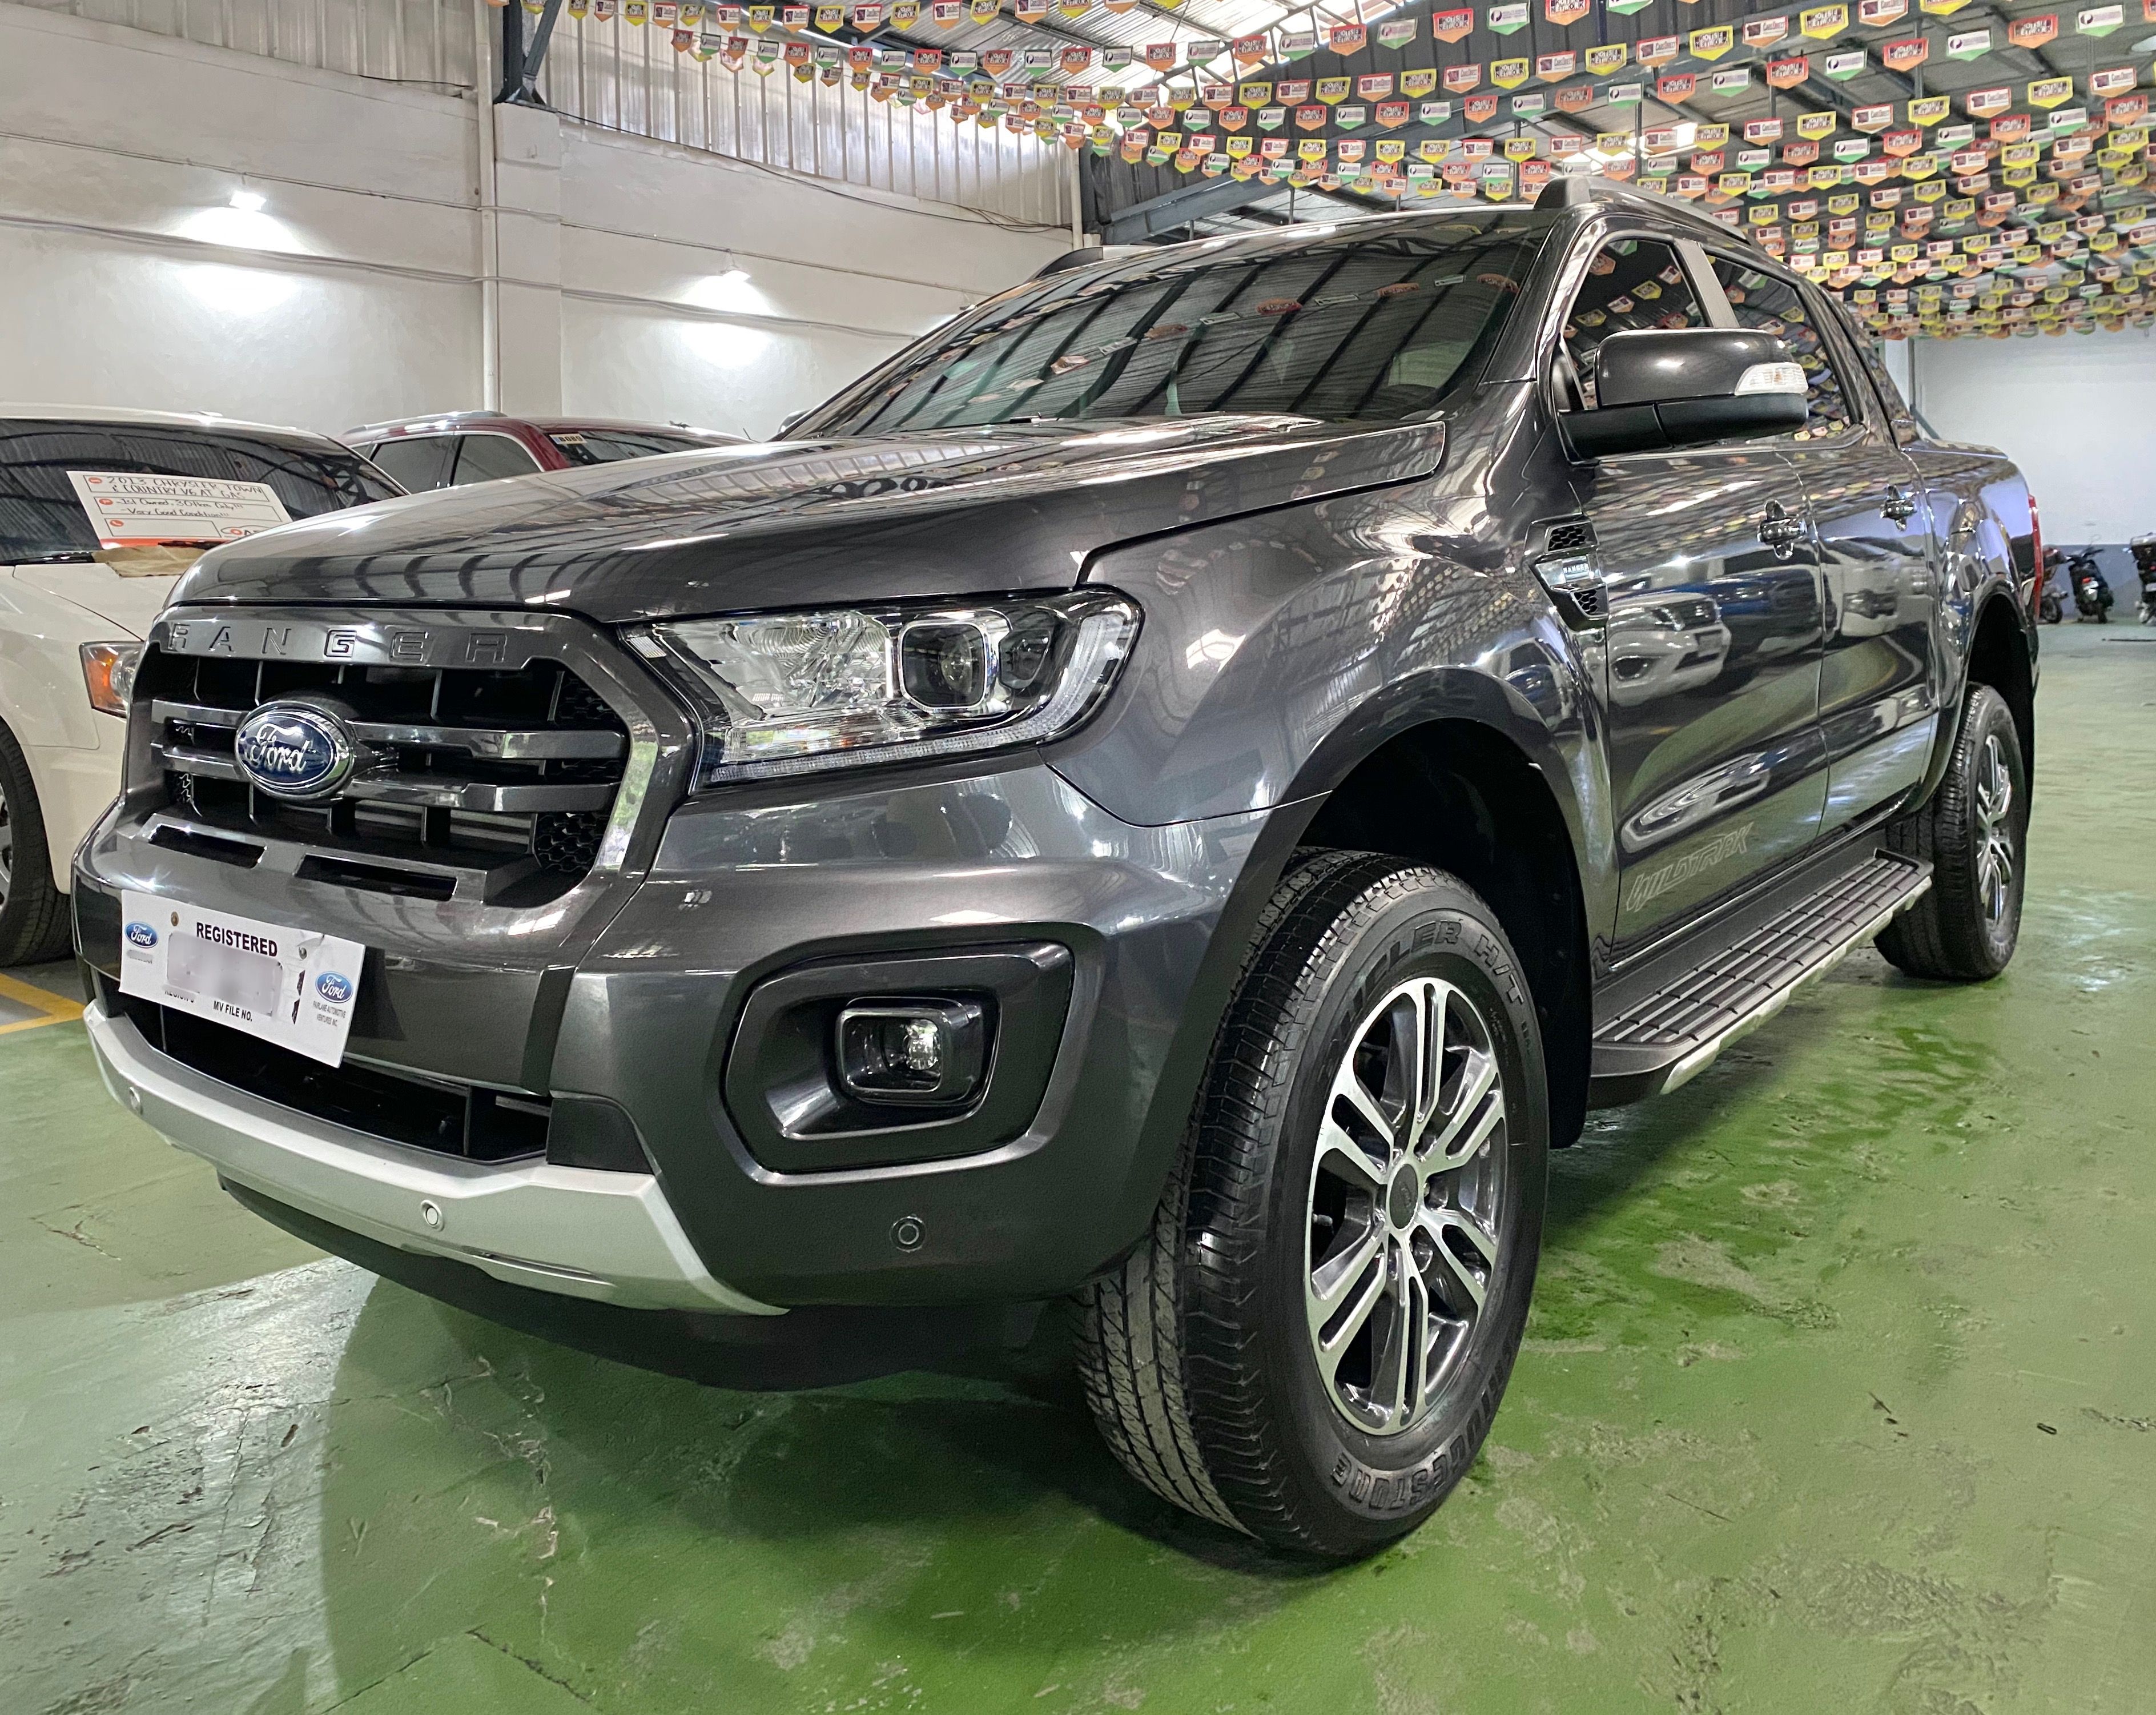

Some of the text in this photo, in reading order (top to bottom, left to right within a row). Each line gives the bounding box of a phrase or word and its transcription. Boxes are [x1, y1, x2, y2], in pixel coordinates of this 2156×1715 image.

[1551, 3, 1583, 13] NETWORK
[123, 485, 176, 495] COUNTRY
[180, 488, 197, 496] V6
[220, 491, 246, 499] GAS
[154, 479, 220, 490] CHRYSLER
[226, 484, 262, 493] TOWN
[1563, 563, 1590, 573] RANGER
[169, 622, 509, 663] RANGER
[1626, 821, 1754, 913] WILDTRAK
[131, 924, 152, 945] Ford
[196, 922, 277, 957] REGISTERED
[321, 974, 348, 999] Ford
[213, 1000, 253, 1022] MV FILE NO.
